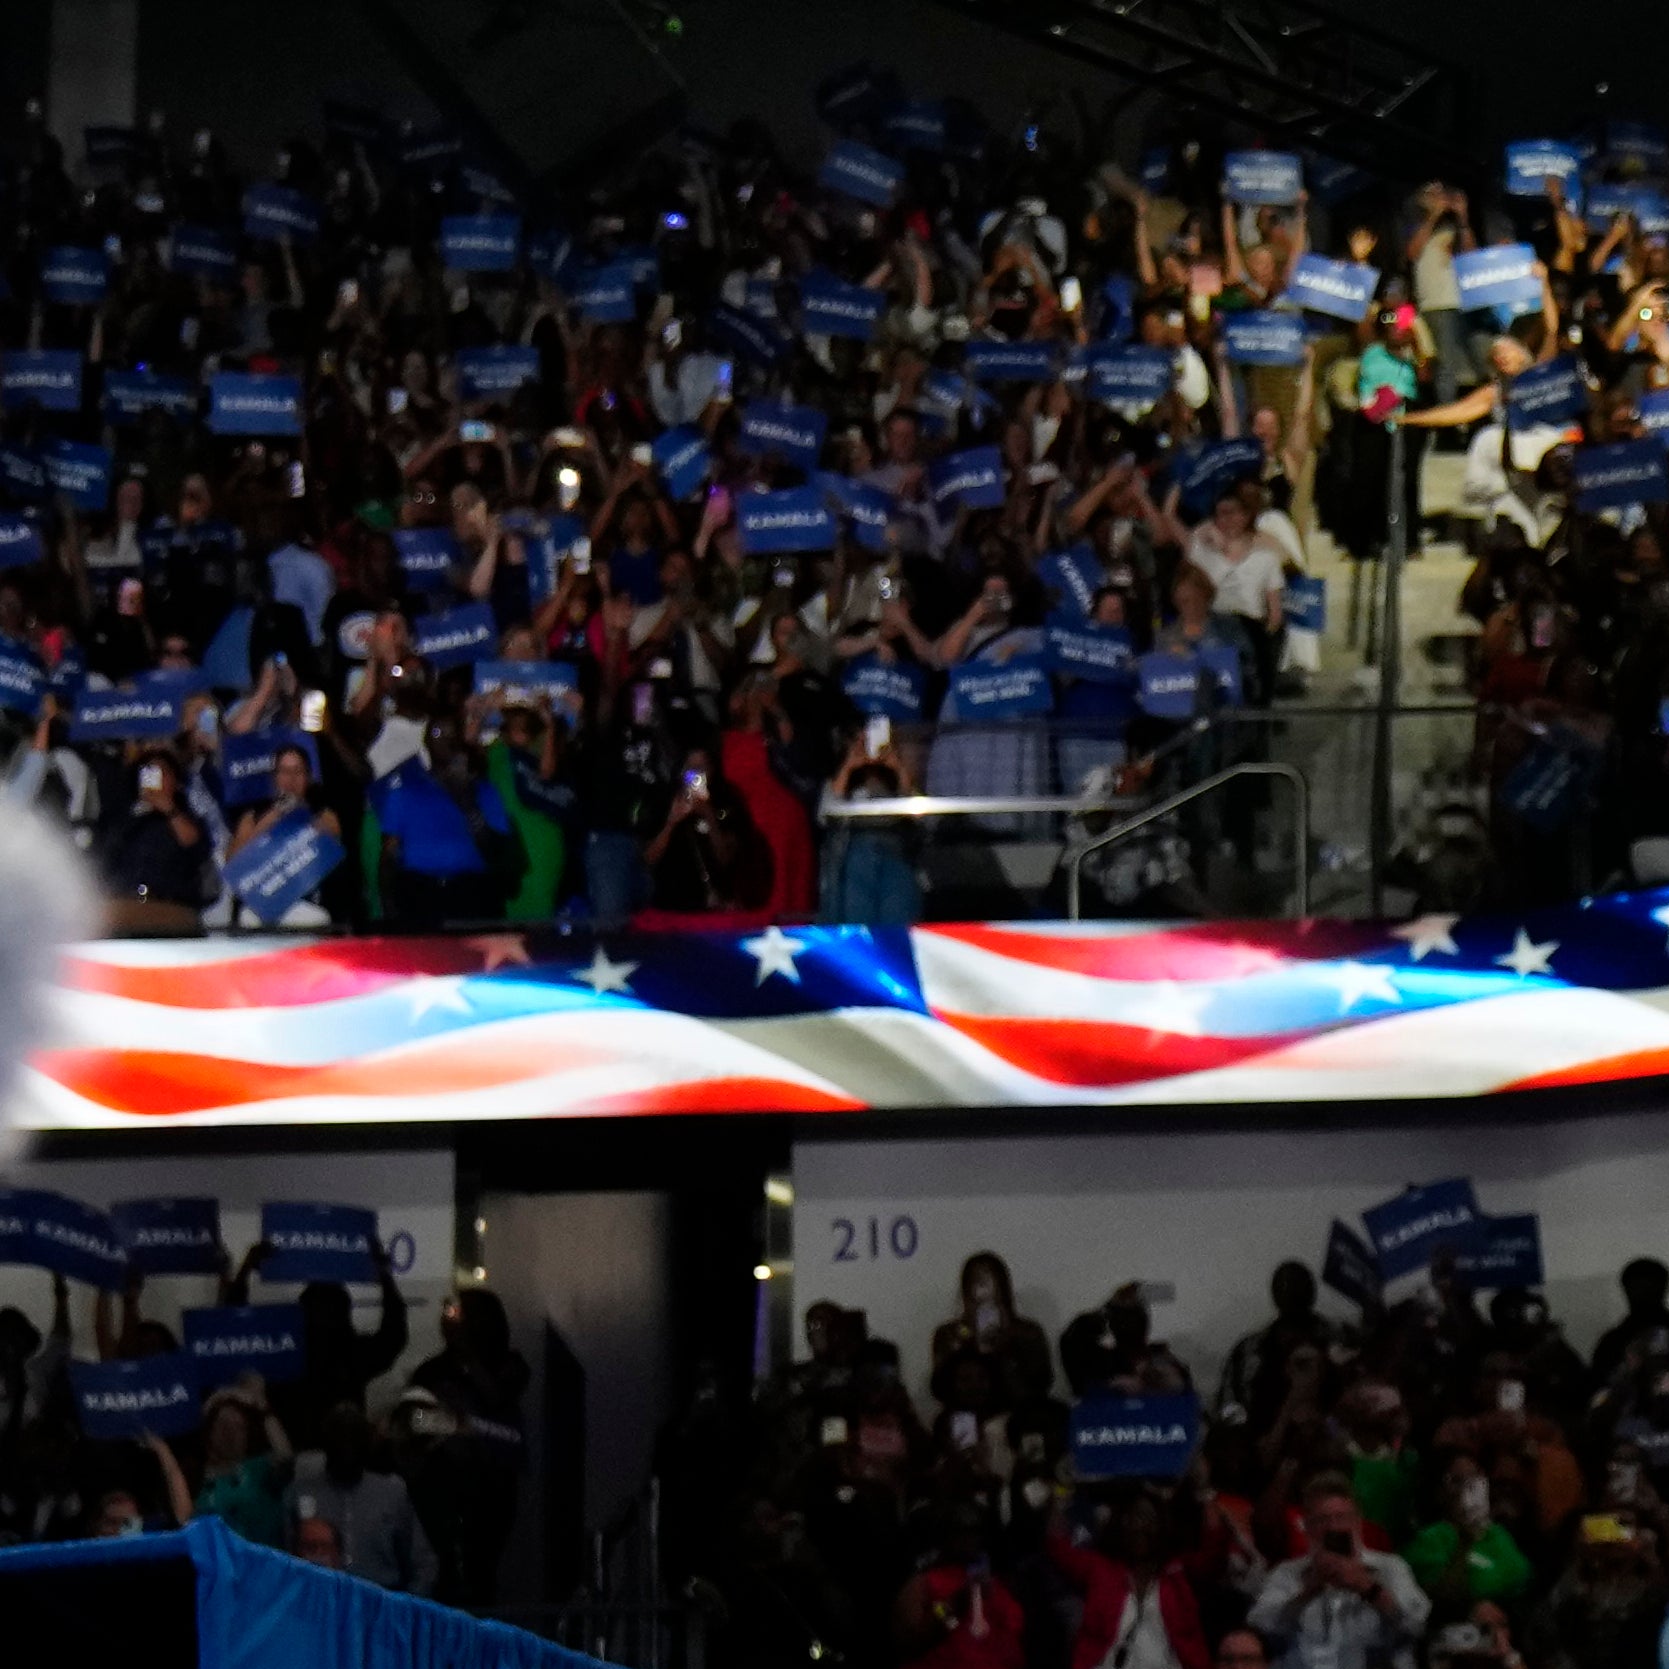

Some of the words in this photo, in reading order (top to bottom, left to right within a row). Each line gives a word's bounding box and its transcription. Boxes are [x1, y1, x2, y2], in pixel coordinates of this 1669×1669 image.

[135, 1227, 212, 1246] AMALA
[269, 1231, 368, 1252] KAMALA
[832, 1215, 919, 1265] 210
[83, 1385, 188, 1411] KAMALA
[1077, 1425, 1187, 1445] KAMALA
